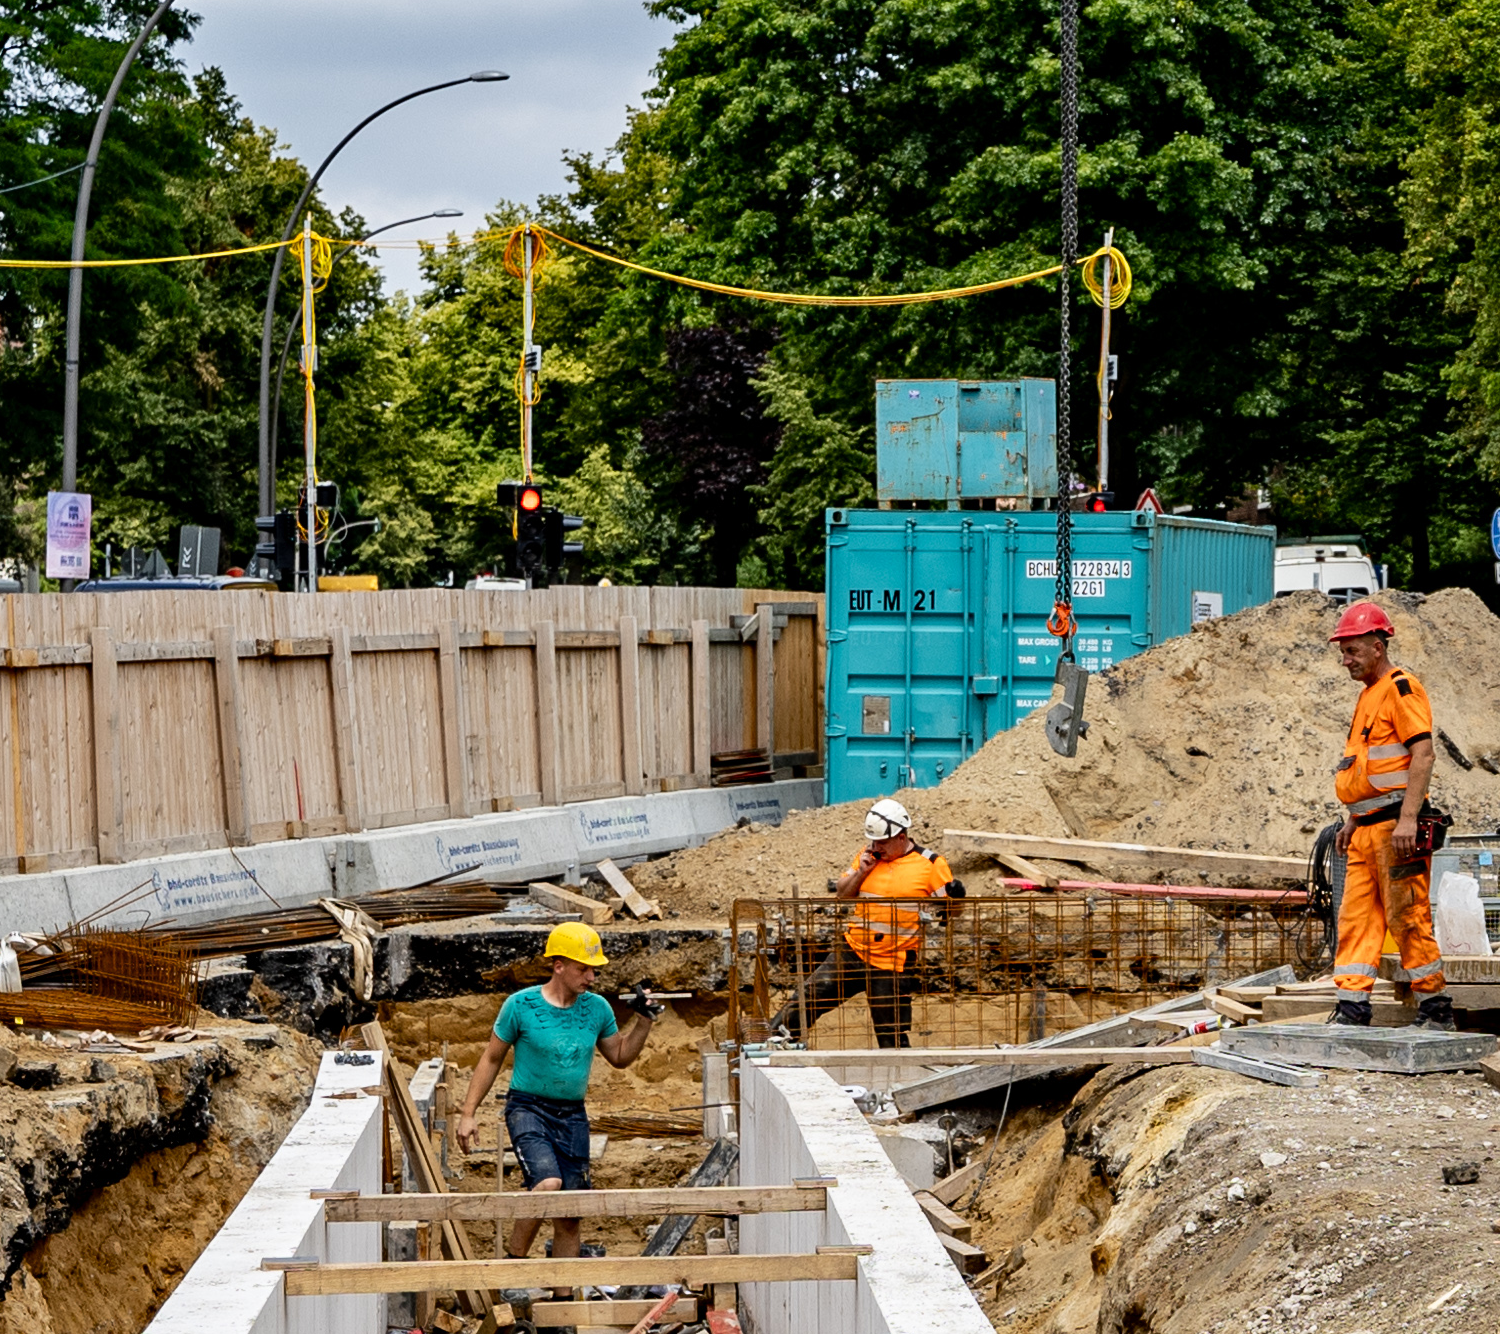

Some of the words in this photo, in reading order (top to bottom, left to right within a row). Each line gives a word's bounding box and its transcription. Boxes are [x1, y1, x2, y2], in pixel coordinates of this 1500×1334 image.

[1073, 562, 1118, 576] 122834
[1124, 563, 1130, 576] 3
[1074, 581, 1103, 595] 22G1
[850, 590, 873, 610] EUT
[914, 590, 935, 610] 21
[1018, 656, 1036, 664] TARE
